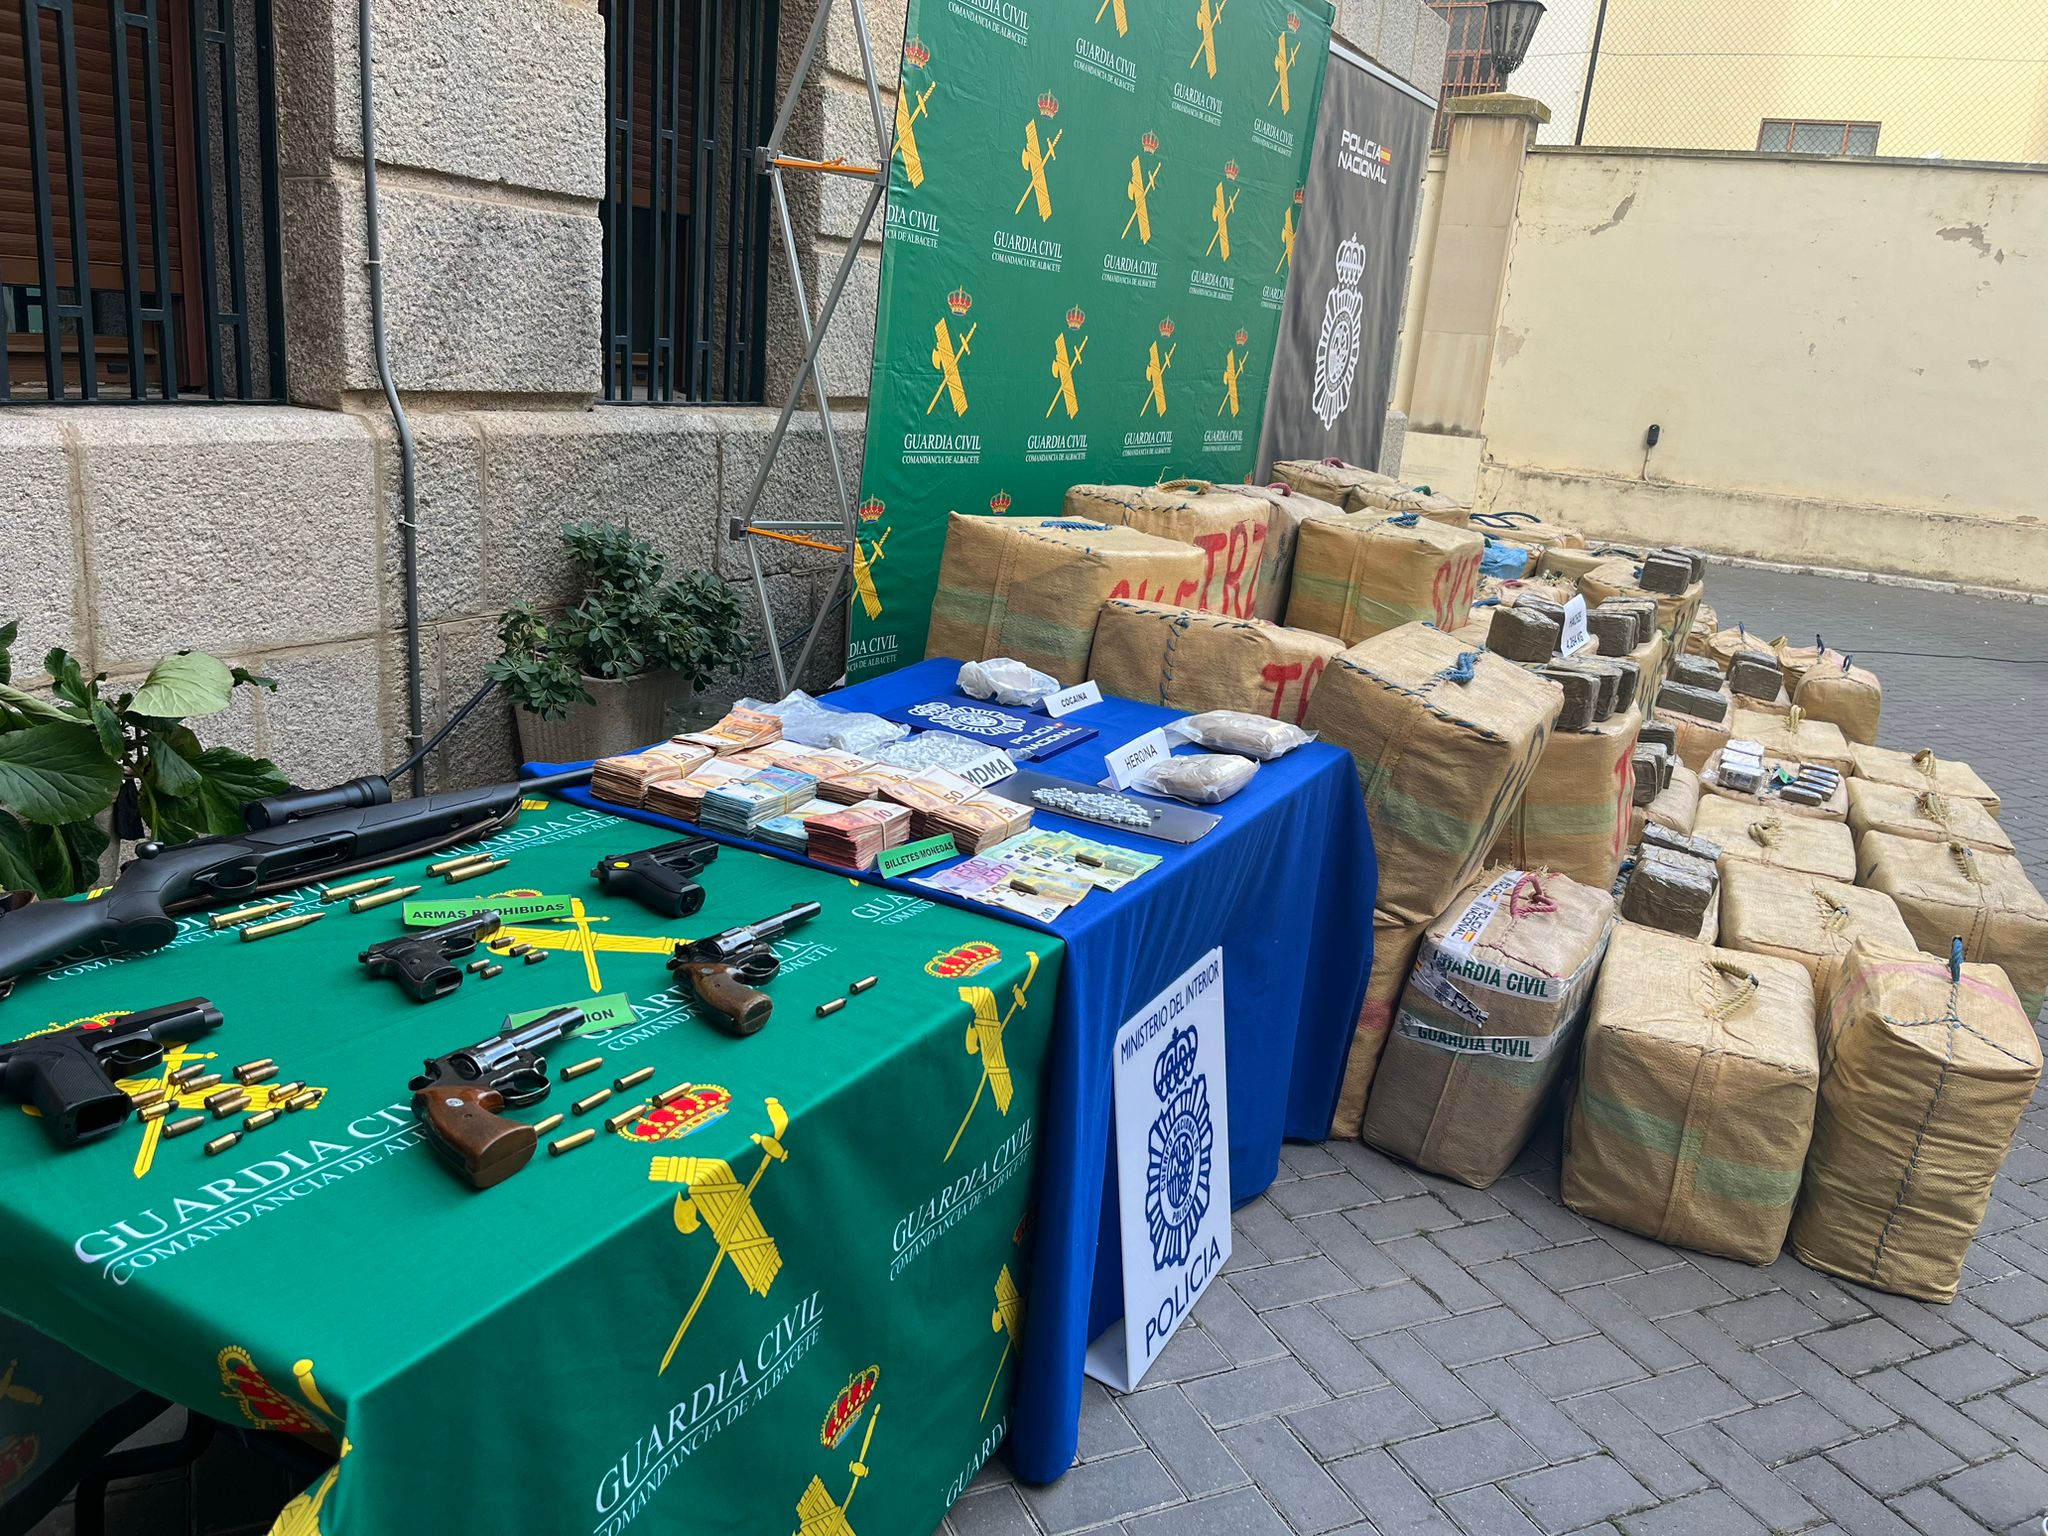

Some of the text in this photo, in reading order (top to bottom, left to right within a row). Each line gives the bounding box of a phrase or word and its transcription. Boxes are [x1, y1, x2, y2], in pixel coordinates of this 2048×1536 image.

[948, 1, 1028, 47] COMANDANCIA DE ALBACETE
[1002, 2, 1030, 31] CIVIL
[1075, 37, 1137, 79] GUARDIA CIVIL
[1173, 82, 1223, 114] GUARDIA CIVIL
[1254, 118, 1280, 140] GUARDIA
[1279, 129, 1294, 147] CIVIL
[1337, 150, 1387, 185] NACIONAL
[909, 209, 940, 232] CIVIL
[897, 231, 907, 242] DE
[906, 233, 939, 249] ALBACETE
[993, 231, 1063, 258] GUARDIA CIVIL
[991, 253, 1061, 273] COMANDANCIA DE ALBACETE
[1103, 253, 1158, 276] GUARDIA CIVIL
[1191, 269, 1235, 290] GUARDIA CIVIL
[904, 433, 981, 450] GUARDIA CIVIL
[1027, 434, 1088, 450] GUARDIA CIVIL
[1124, 431, 1173, 446] GUARDIA CIVIL
[1204, 430, 1244, 442] GUARDIA CIVIL
[902, 455, 980, 465] COMANDANCIA DE ALBACETE
[1025, 451, 1087, 463] COMANDANCIA DE ALBACETE
[868, 634, 898, 652] CIVIL
[867, 654, 897, 667] ALBACETE
[1061, 692, 1088, 708] COCAINA
[1020, 727, 1083, 752] NACIONAL
[673, 752, 695, 763] 50
[843, 759, 864, 768] 50
[1124, 744, 1158, 771] HEROINA
[960, 758, 1012, 787] MDMA
[944, 790, 964, 804] 50
[873, 809, 893, 820] 10
[998, 807, 1018, 819] 50
[412, 910, 467, 919] ARMAS
[1506, 973, 1549, 998] CIVIL
[1121, 960, 1220, 1065] MINISTERIO DEL INTERIOR
[1418, 1026, 1533, 1058] GUARDIA CIVIL
[893, 1117, 1033, 1252] GUARDIA CIVIL
[74, 1140, 354, 1264] GUARDIA
[112, 1151, 383, 1286] COMANDANCIA DE
[890, 1204, 968, 1282] COMANDANCIA
[968, 1190, 983, 1212] DE
[1145, 1236, 1221, 1358] POLICIA
[726, 1395, 750, 1426] DE
[751, 1325, 821, 1407] ALBACETE
[595, 1289, 824, 1514] GUARDIA CIVIL
